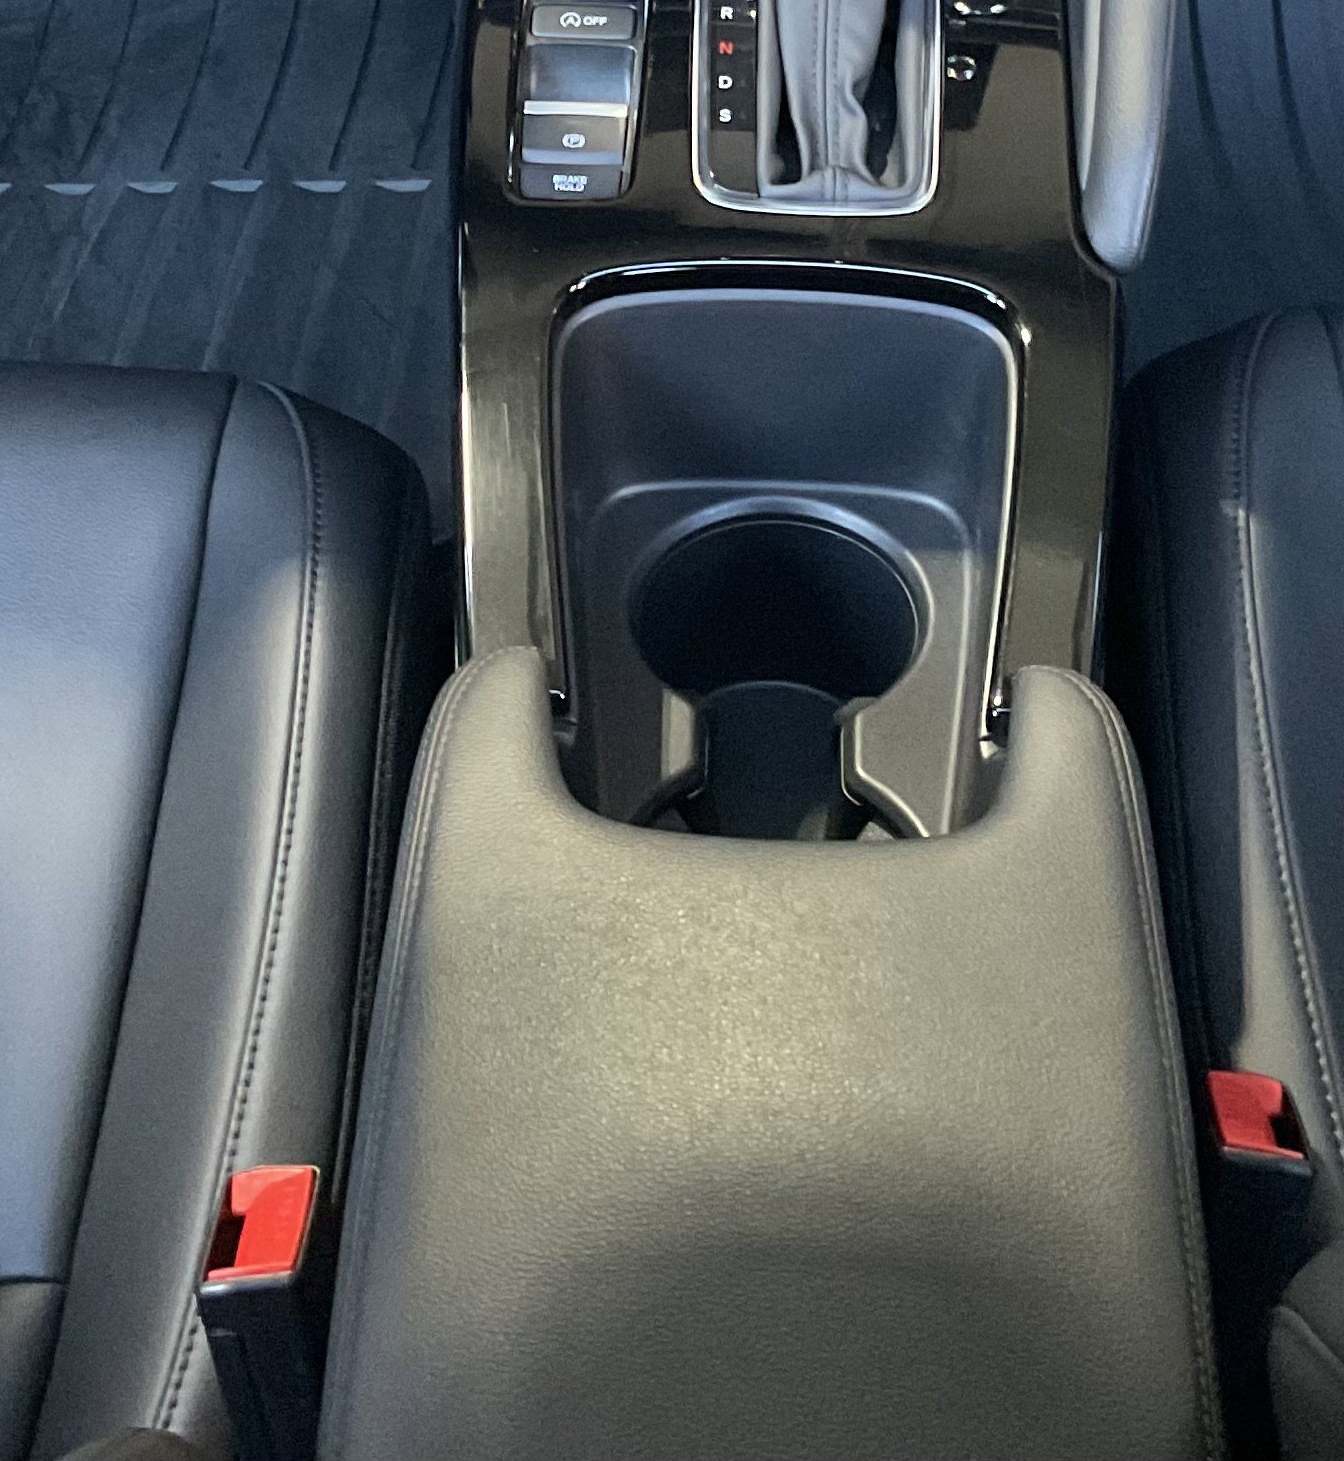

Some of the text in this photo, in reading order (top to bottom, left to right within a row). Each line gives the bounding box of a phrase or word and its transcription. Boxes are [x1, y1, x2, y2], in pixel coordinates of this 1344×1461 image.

[720, 6, 734, 20] R
[582, 15, 608, 27] OFF
[719, 41, 734, 55] N
[718, 75, 733, 90] D
[719, 108, 732, 122] S
